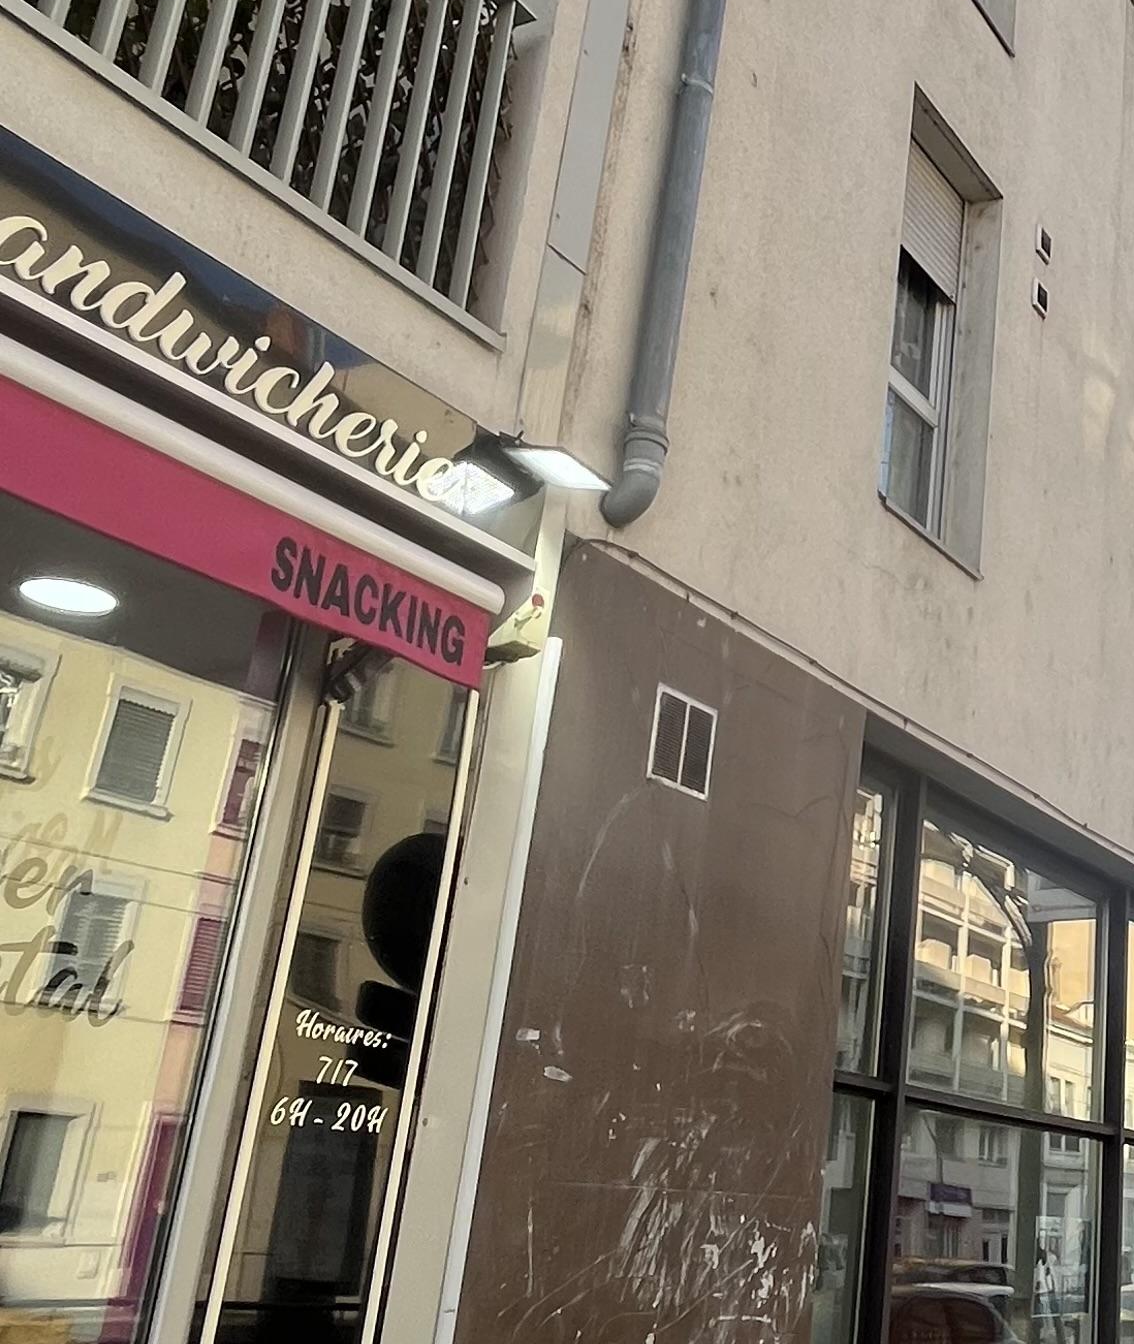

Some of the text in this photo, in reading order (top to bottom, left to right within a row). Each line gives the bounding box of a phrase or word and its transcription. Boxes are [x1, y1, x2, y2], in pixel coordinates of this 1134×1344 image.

[271, 536, 465, 666] SNACKING
[295, 1009, 392, 1048] Horaires:
[316, 1056, 359, 1087] 7/7
[270, 1096, 312, 1127] 6H
[331, 1102, 388, 1133] 20H
